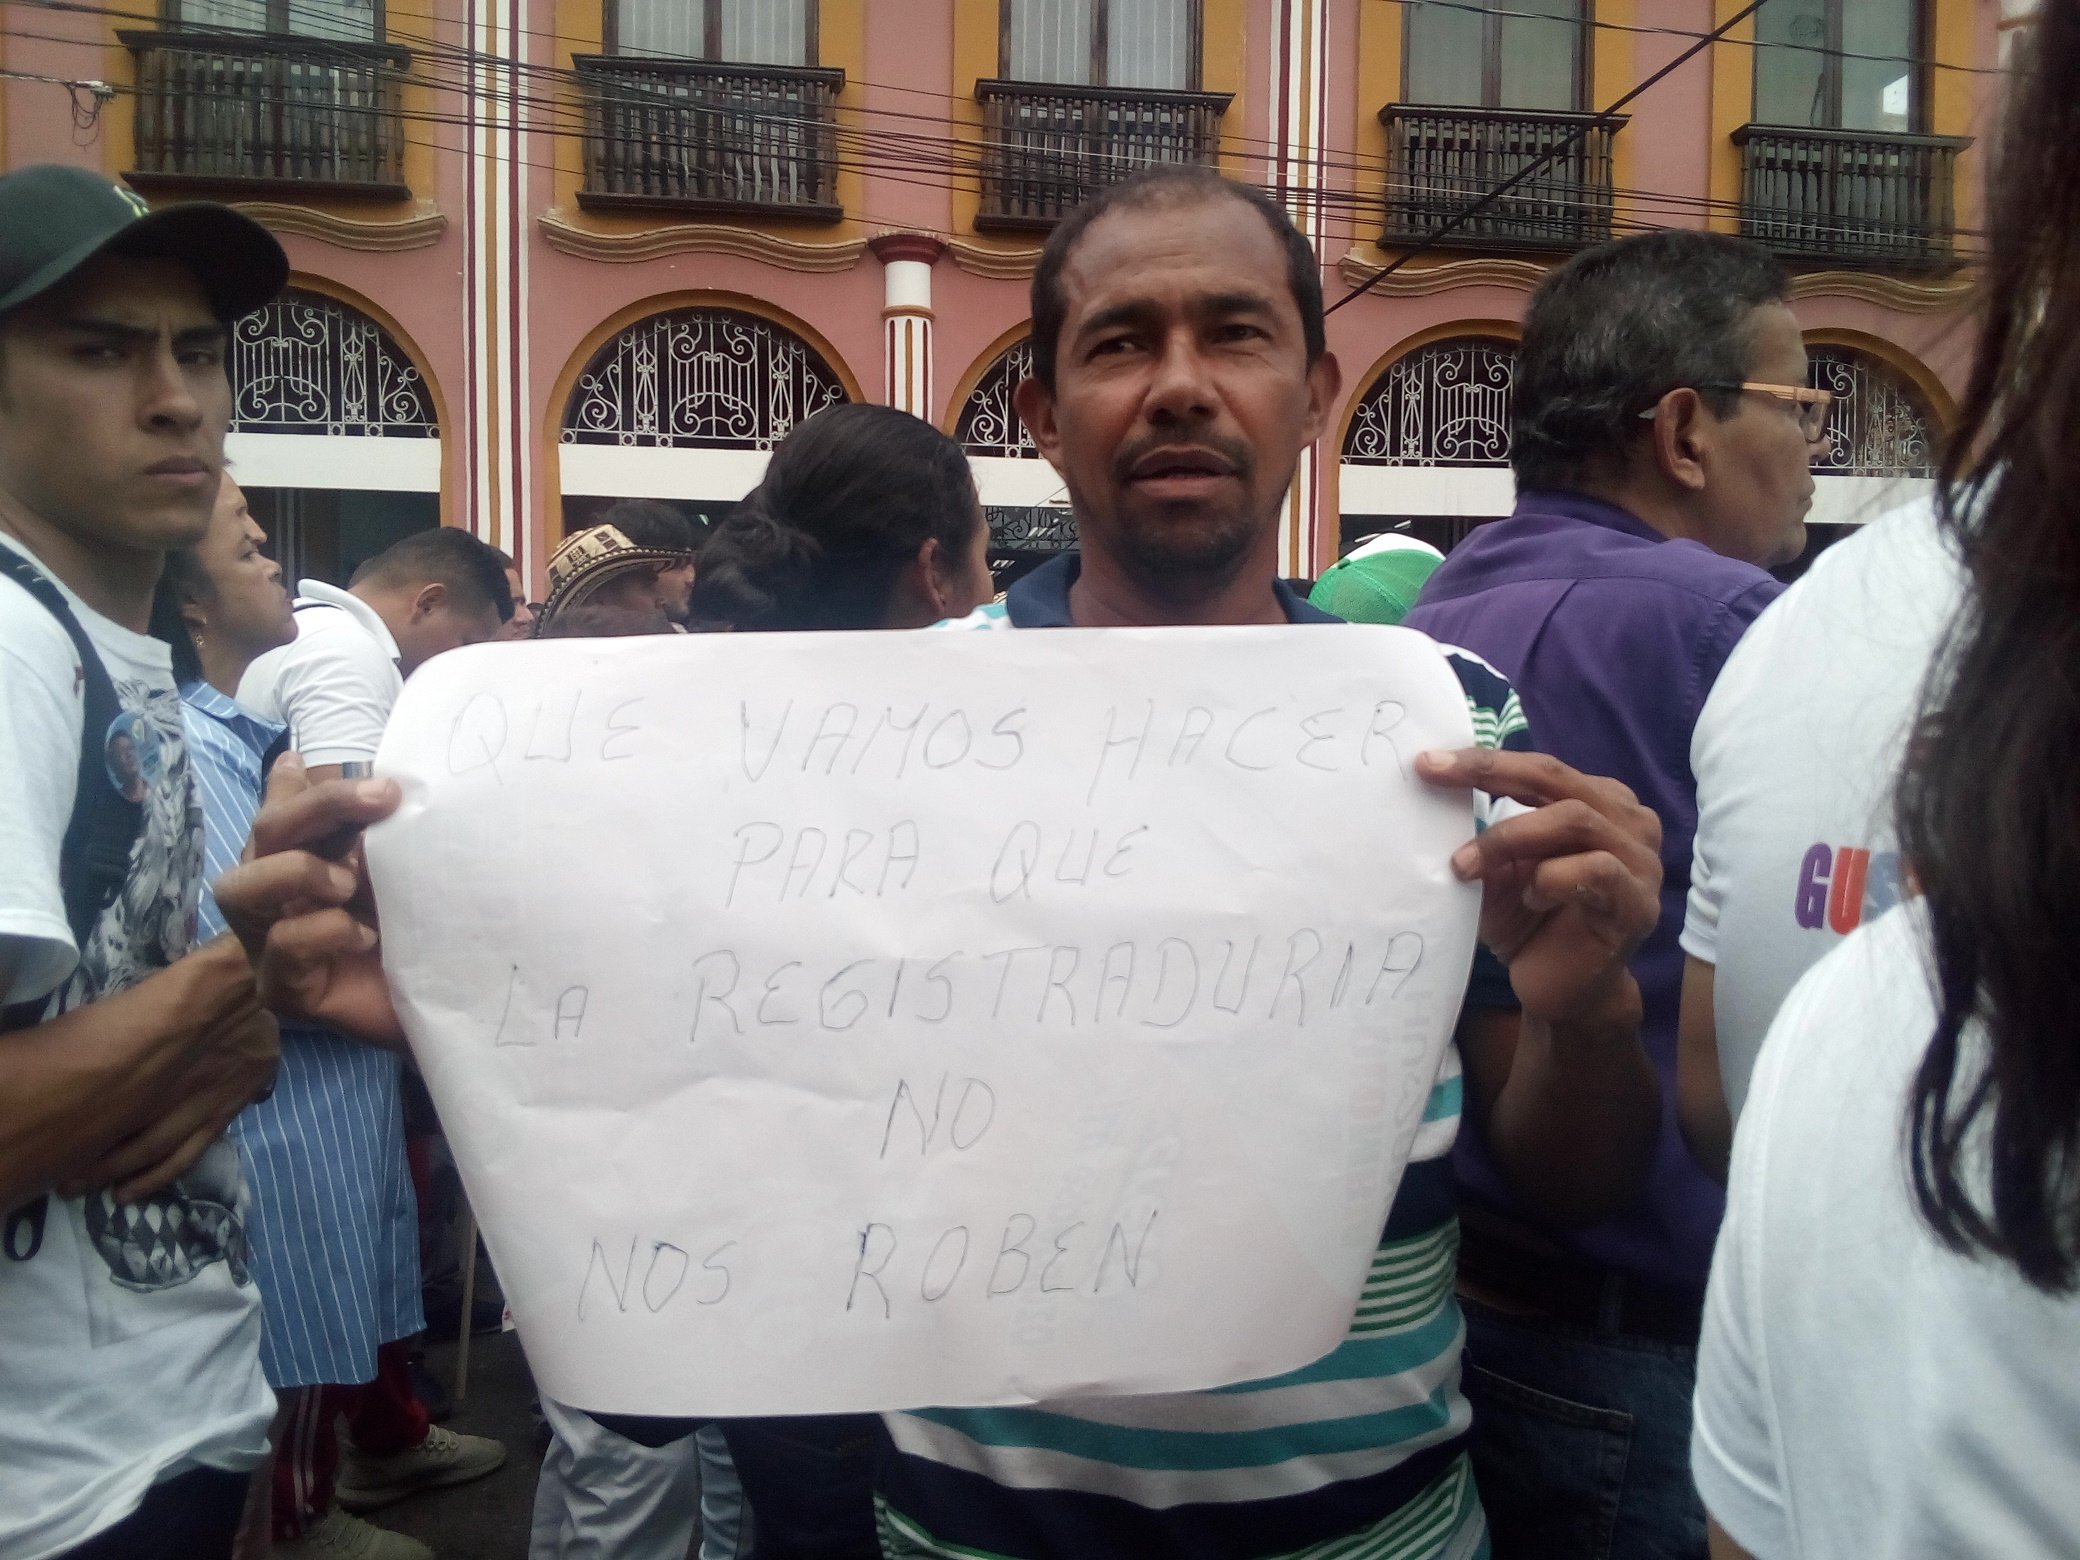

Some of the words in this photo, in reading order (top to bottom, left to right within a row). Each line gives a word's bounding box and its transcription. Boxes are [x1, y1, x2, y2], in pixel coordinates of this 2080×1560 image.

[447, 689, 645, 786] QUE
[738, 698, 1027, 783] VAMOS
[1086, 698, 1408, 806] HACER
[726, 819, 920, 908] PARA
[990, 820, 1149, 904] QUE
[689, 928, 1426, 1044] REGISTRADURIA
[880, 1071, 998, 1160] NO
[577, 1234, 738, 1323] NOS
[846, 1209, 1159, 1320] ROBEN
